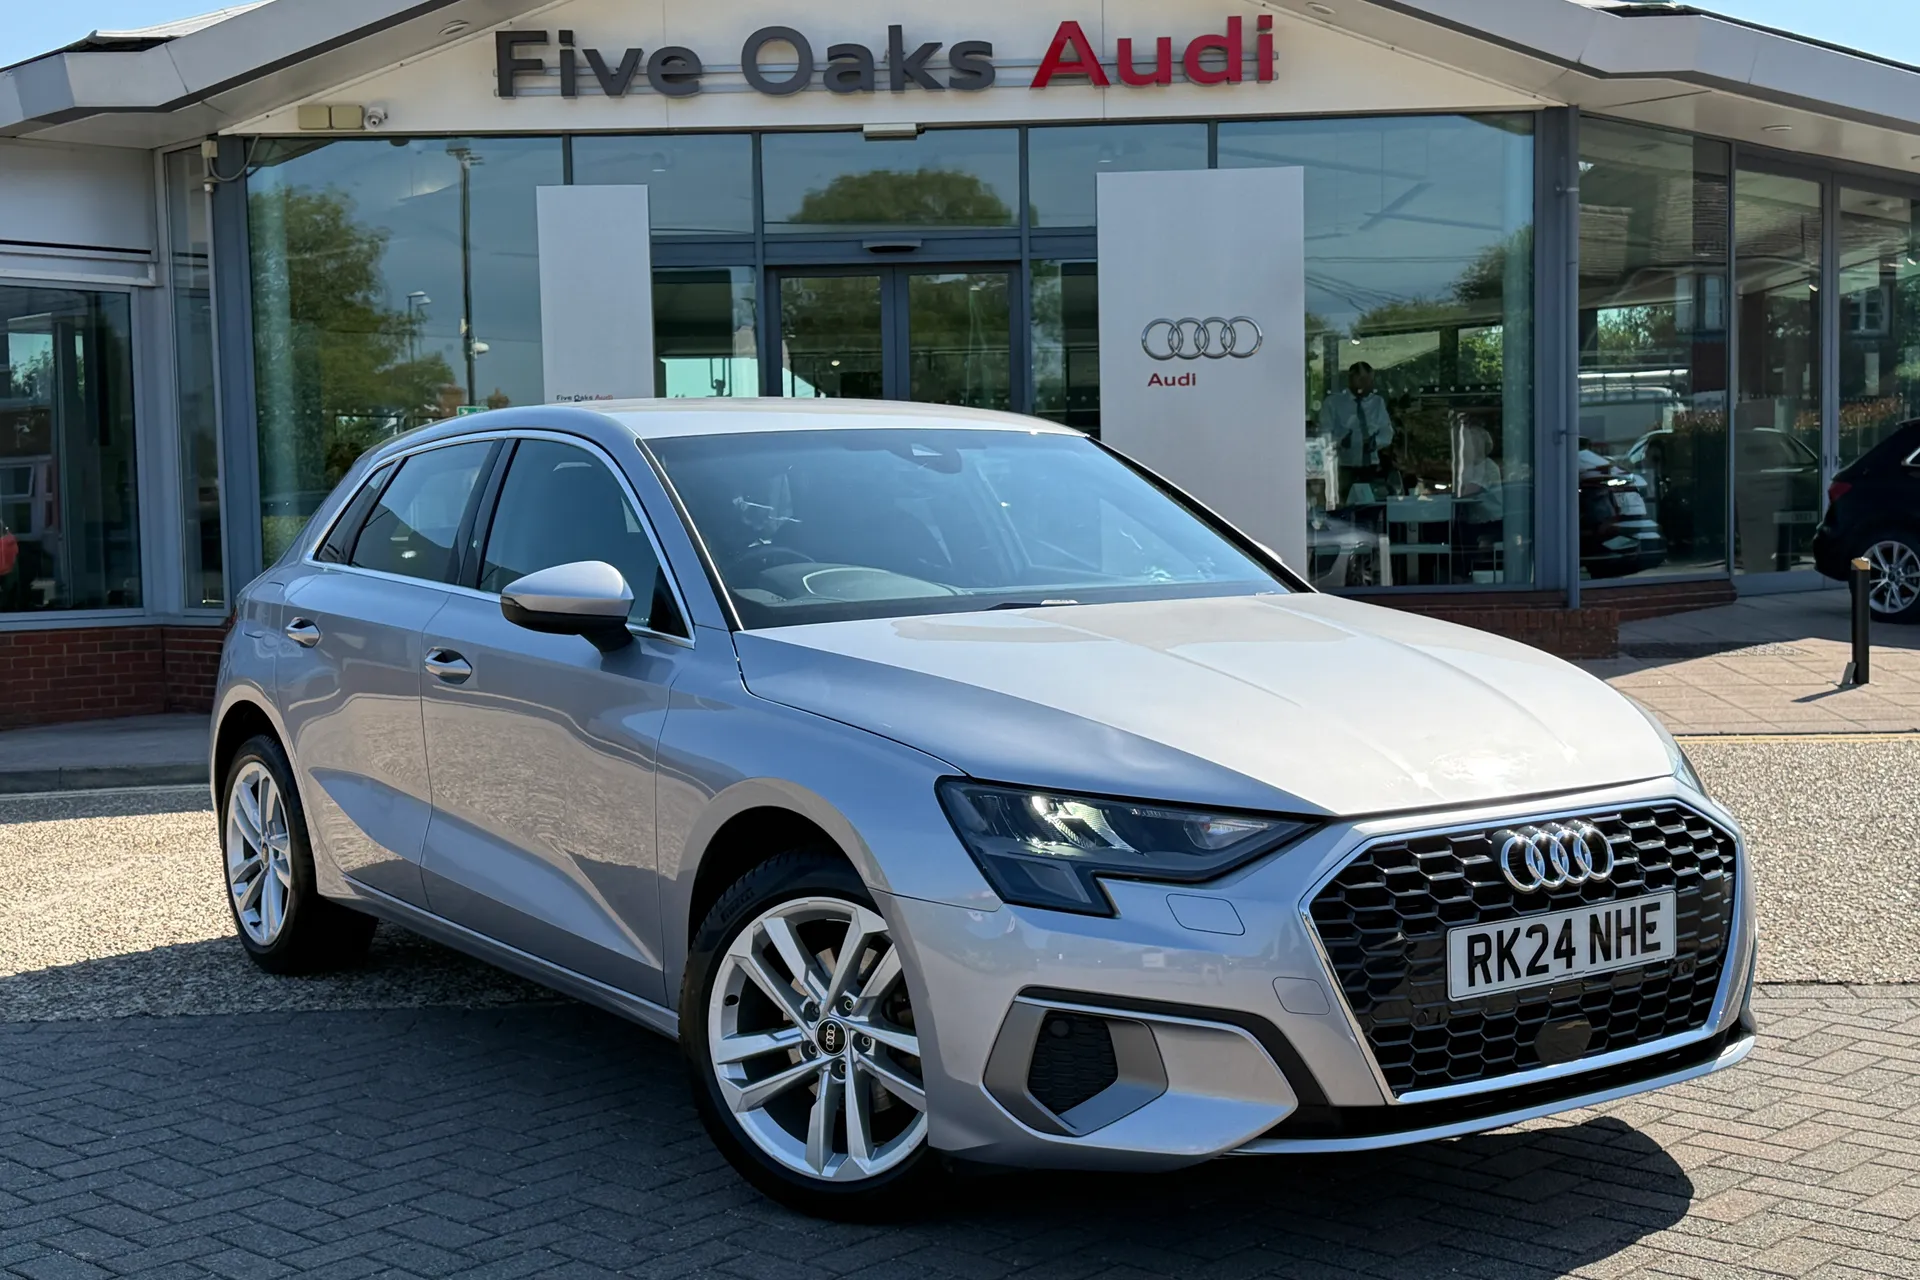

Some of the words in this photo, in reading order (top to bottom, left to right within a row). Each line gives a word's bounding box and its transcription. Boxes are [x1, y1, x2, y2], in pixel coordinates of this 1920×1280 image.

[496, 29, 702, 98] Five
[741, 24, 996, 96] Oaks
[1029, 14, 1273, 89] Audi
[1147, 372, 1196, 387] Audi
[1467, 918, 1576, 988] RK24
[1589, 901, 1661, 965] NHE
